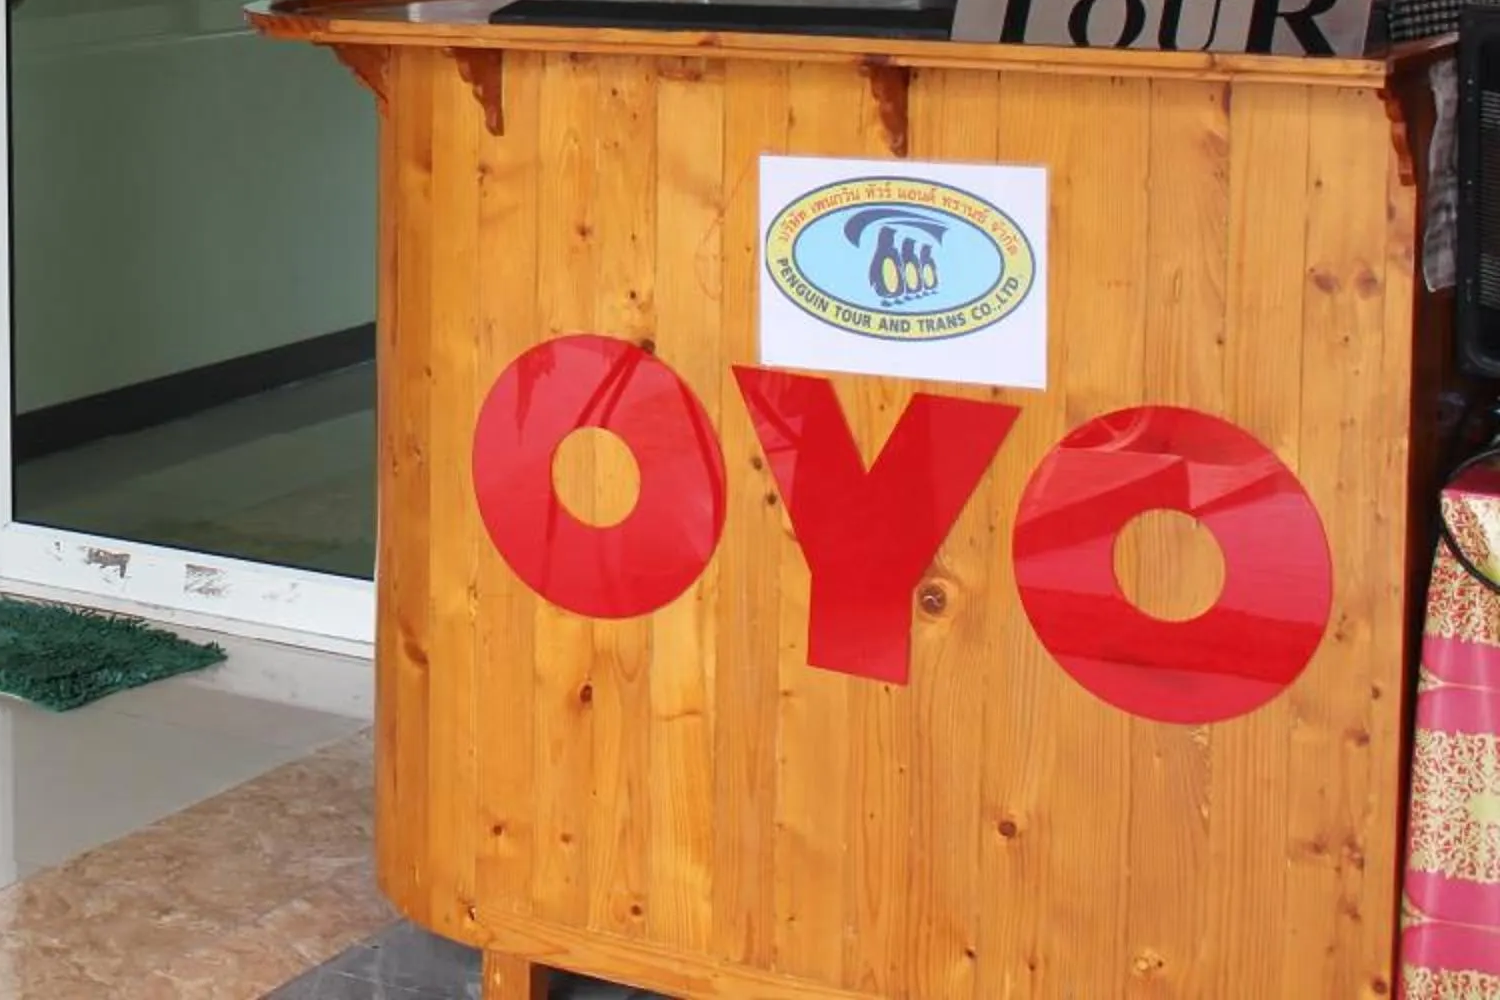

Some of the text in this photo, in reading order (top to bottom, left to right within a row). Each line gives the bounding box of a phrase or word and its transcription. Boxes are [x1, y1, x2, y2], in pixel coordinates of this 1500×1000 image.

[776, 257, 830, 313] PENGUIN
[834, 305, 873, 330] TOUR
[878, 315, 911, 334] AND
[916, 313, 967, 334] TRANS
[472, 334, 1333, 724] OYO
